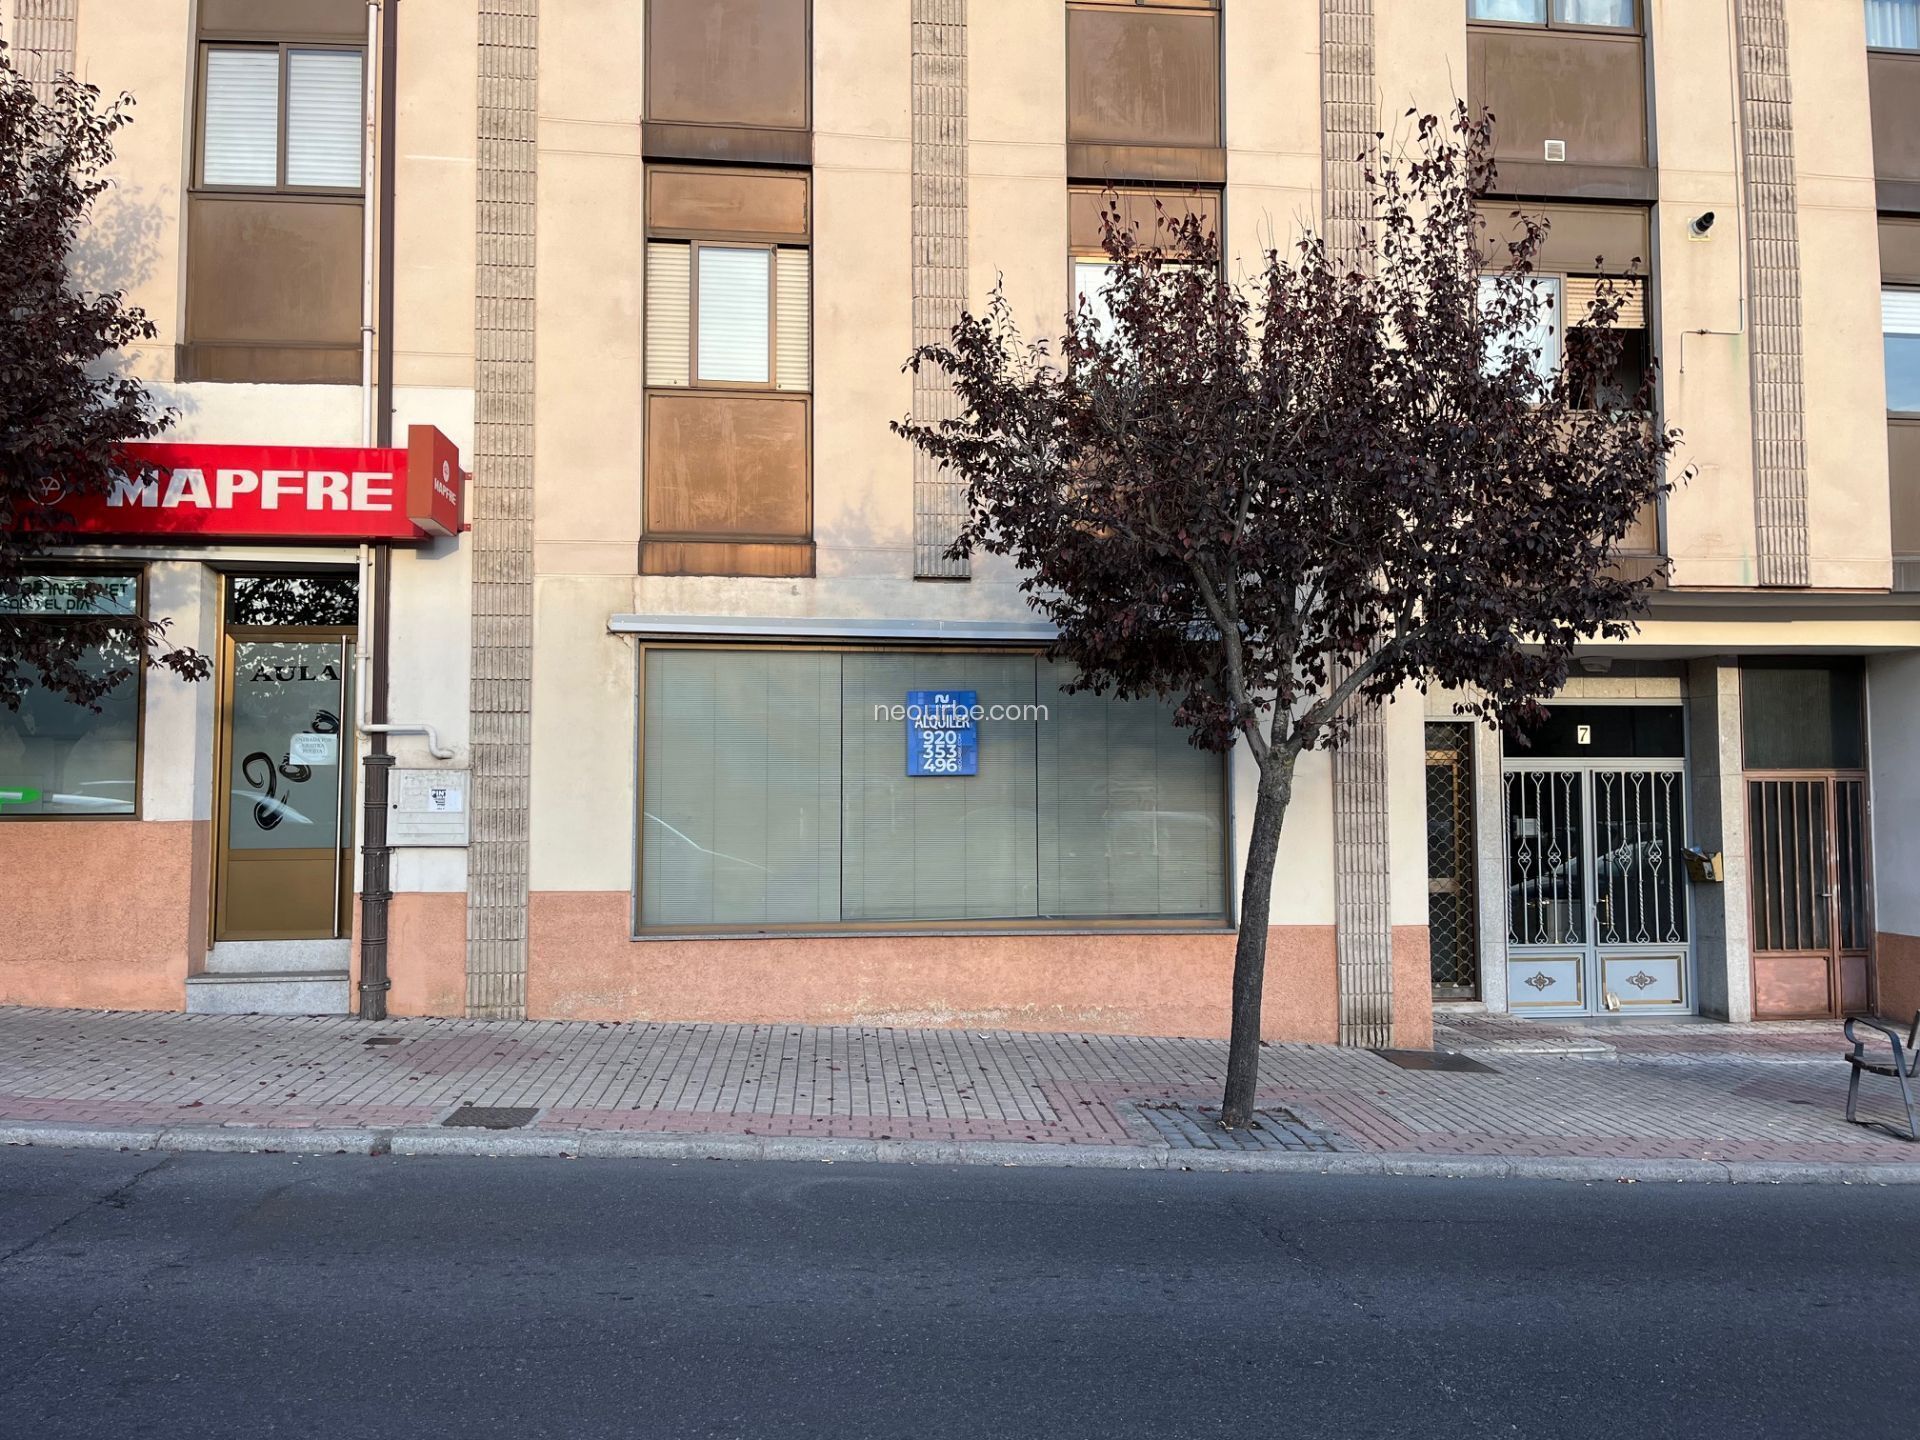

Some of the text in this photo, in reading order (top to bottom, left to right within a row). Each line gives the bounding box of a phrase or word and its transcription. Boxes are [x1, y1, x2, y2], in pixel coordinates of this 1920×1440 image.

[106, 467, 393, 511] MAPFRE
[433, 477, 457, 506] MAPFRE
[250, 665, 341, 682] AULA
[914, 714, 970, 729] ALQUILER
[923, 730, 957, 745] 920
[1579, 727, 1589, 742] 7
[923, 744, 957, 759] 353
[923, 758, 958, 772] 496
